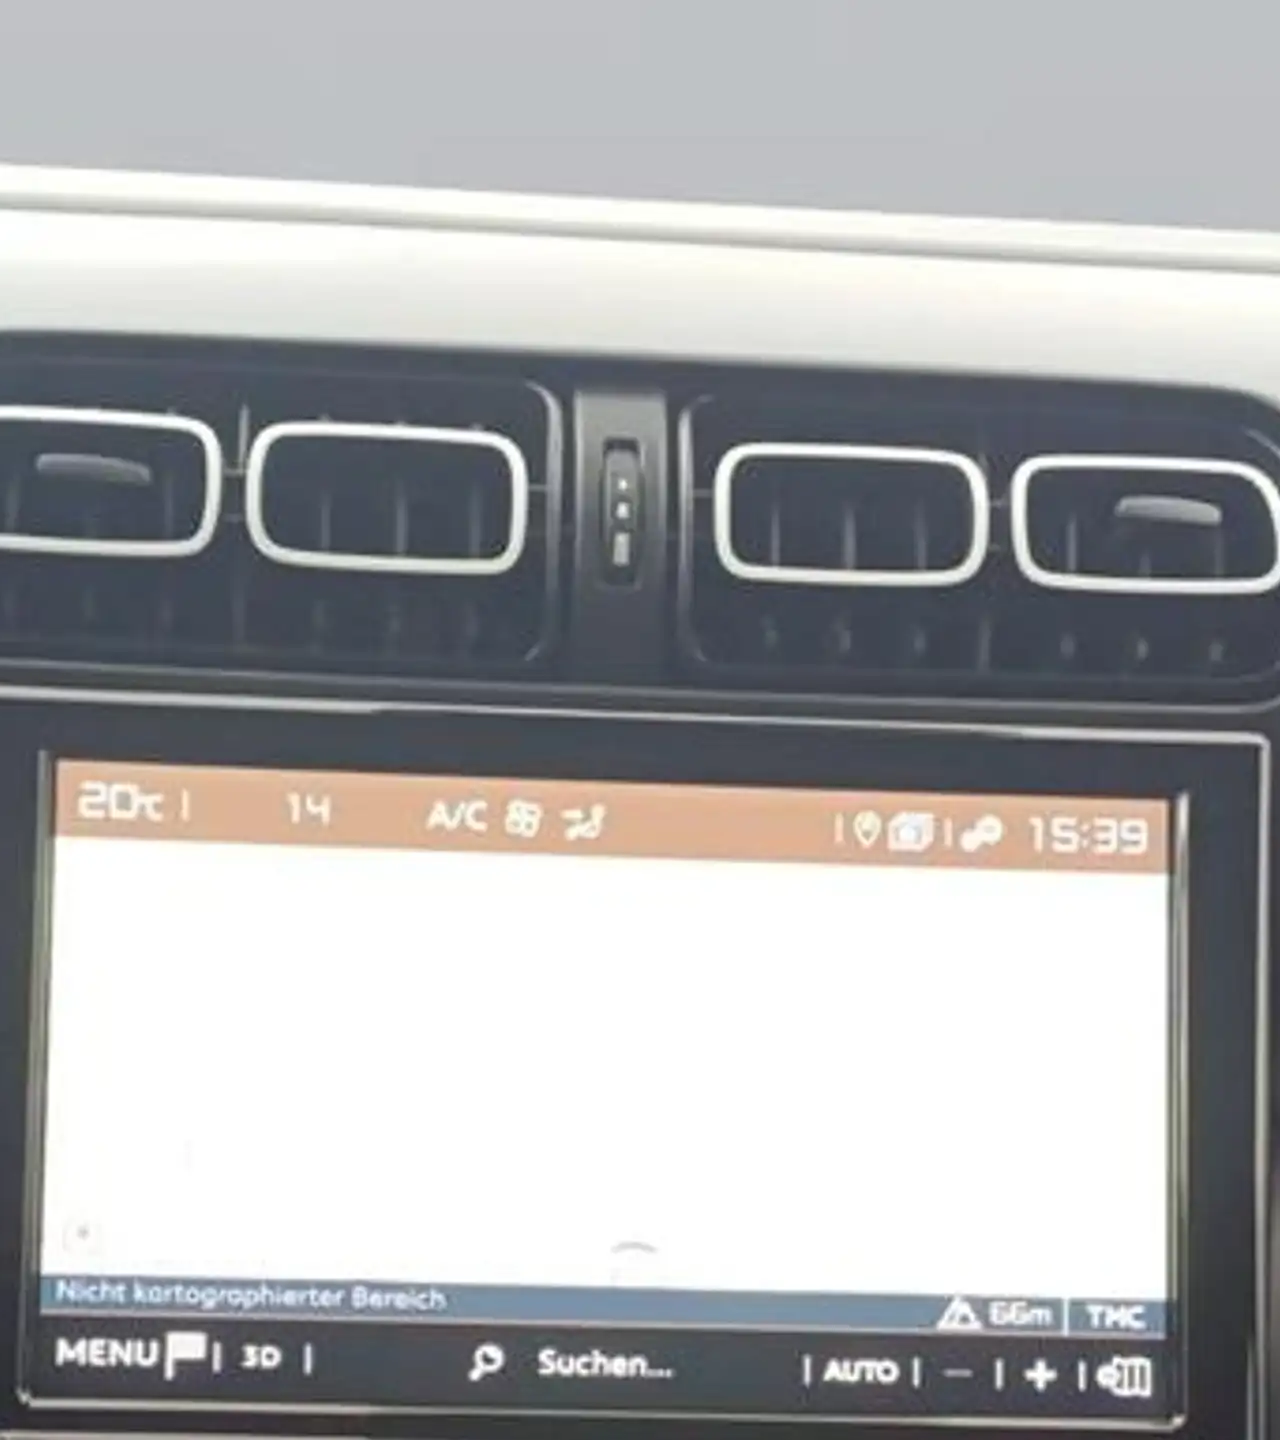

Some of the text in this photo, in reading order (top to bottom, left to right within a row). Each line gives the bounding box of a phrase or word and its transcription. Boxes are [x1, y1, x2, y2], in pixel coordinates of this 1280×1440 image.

[286, 792, 331, 826] 14
[426, 799, 488, 832] A/C
[1029, 816, 1149, 855] 15:39
[56, 1278, 449, 1311] Nicht kartographierter Bereich
[1086, 1304, 1146, 1329] TMC
[54, 1336, 160, 1368] MENU
[241, 1344, 282, 1369] 3D
[823, 1356, 900, 1385] AUTO
